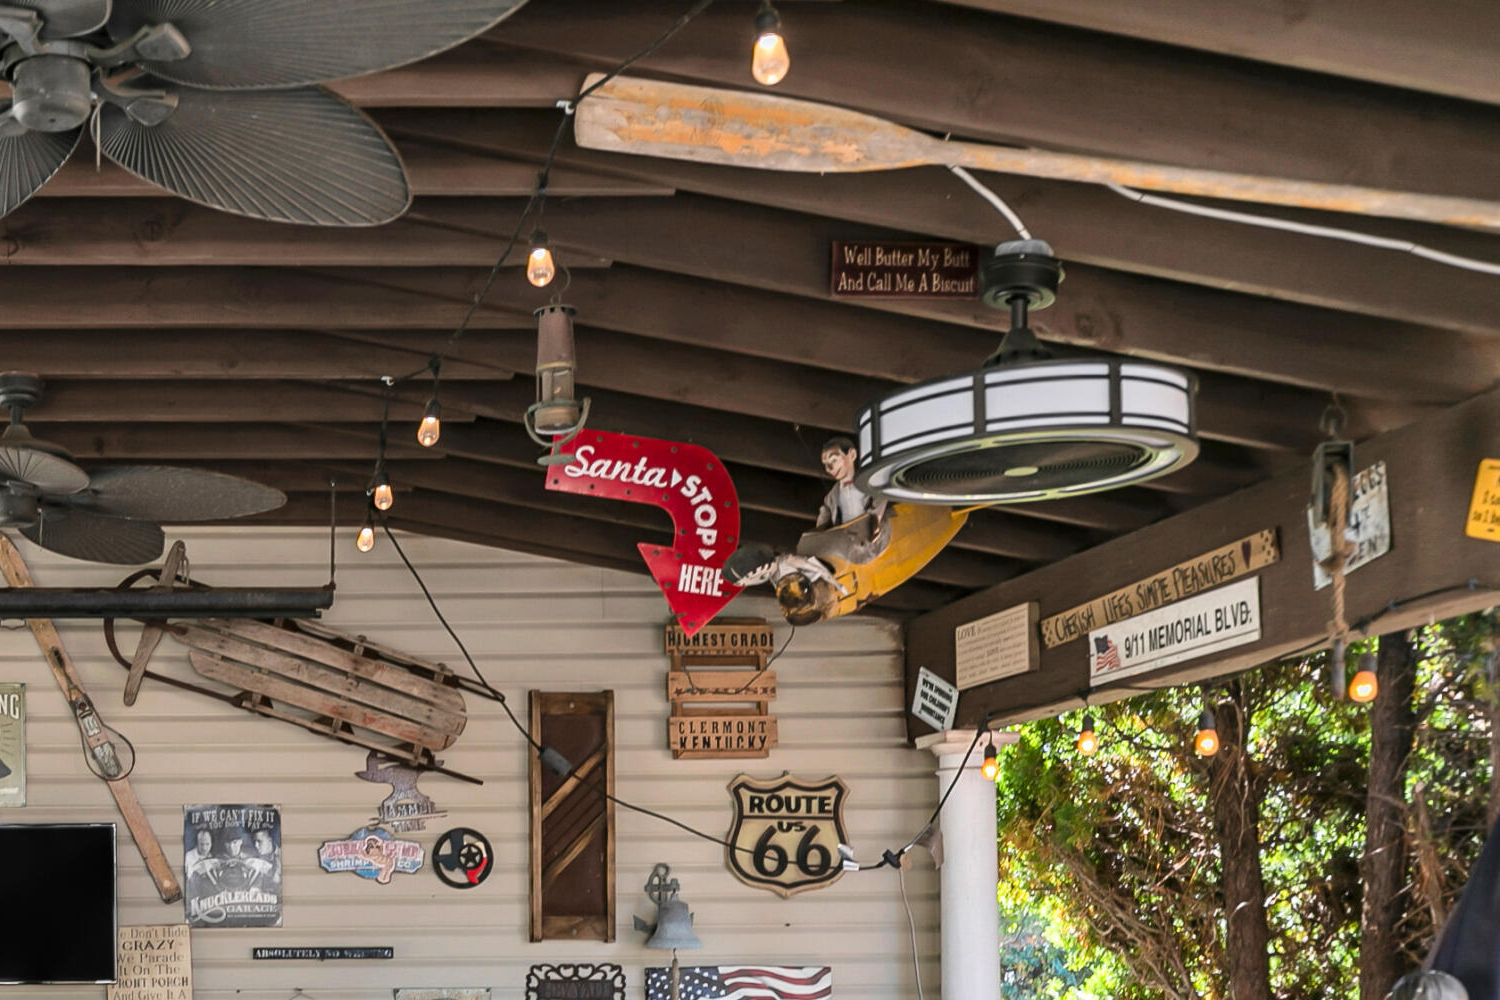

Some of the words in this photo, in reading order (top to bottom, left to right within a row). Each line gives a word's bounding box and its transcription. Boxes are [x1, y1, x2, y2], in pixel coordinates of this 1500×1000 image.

[844, 246, 871, 266] Well
[876, 246, 914, 267] Butter
[917, 248, 939, 271] My
[943, 248, 971, 267] Butt
[838, 272, 863, 291] And
[867, 272, 891, 291] Call
[896, 273, 915, 292] Me
[918, 272, 928, 293] A
[932, 273, 974, 293] Biscuit
[565, 445, 669, 488] Santa
[680, 475, 717, 546] STOP
[678, 564, 723, 597] HERE
[1054, 604, 1096, 640] CHERISH
[1172, 550, 1237, 596] PLEASURES
[1124, 632, 1146, 659] 9/11
[1149, 613, 1211, 650] MEMORIAL
[1215, 600, 1253, 634] BLVD.
[668, 632, 726, 647] HIGHEST
[678, 721, 766, 734] CLERMONT
[680, 735, 767, 749] KENTUCKY
[749, 794, 833, 814] ROUTE
[192, 812, 200, 824] IF
[203, 810, 218, 822] WE
[220, 809, 245, 821] CAN'T
[248, 810, 263, 822] FIX
[266, 811, 275, 823] IT
[777, 821, 807, 833] US
[753, 824, 831, 877] 66
[330, 859, 369, 868] SHRIMP
[190, 888, 278, 916] KNUCKLEHEADS
[227, 904, 277, 913] GARAGE
[162, 927, 187, 938] Hide
[122, 940, 174, 951] CRAZY
[140, 952, 184, 963] Parade
[255, 949, 321, 958] ABSOLUTELY
[325, 949, 340, 958] NO
[133, 965, 150, 976] On
[155, 964, 180, 975] The
[152, 976, 188, 988] PORCH
[113, 990, 134, 1000] And
[138, 990, 162, 1000] Give
